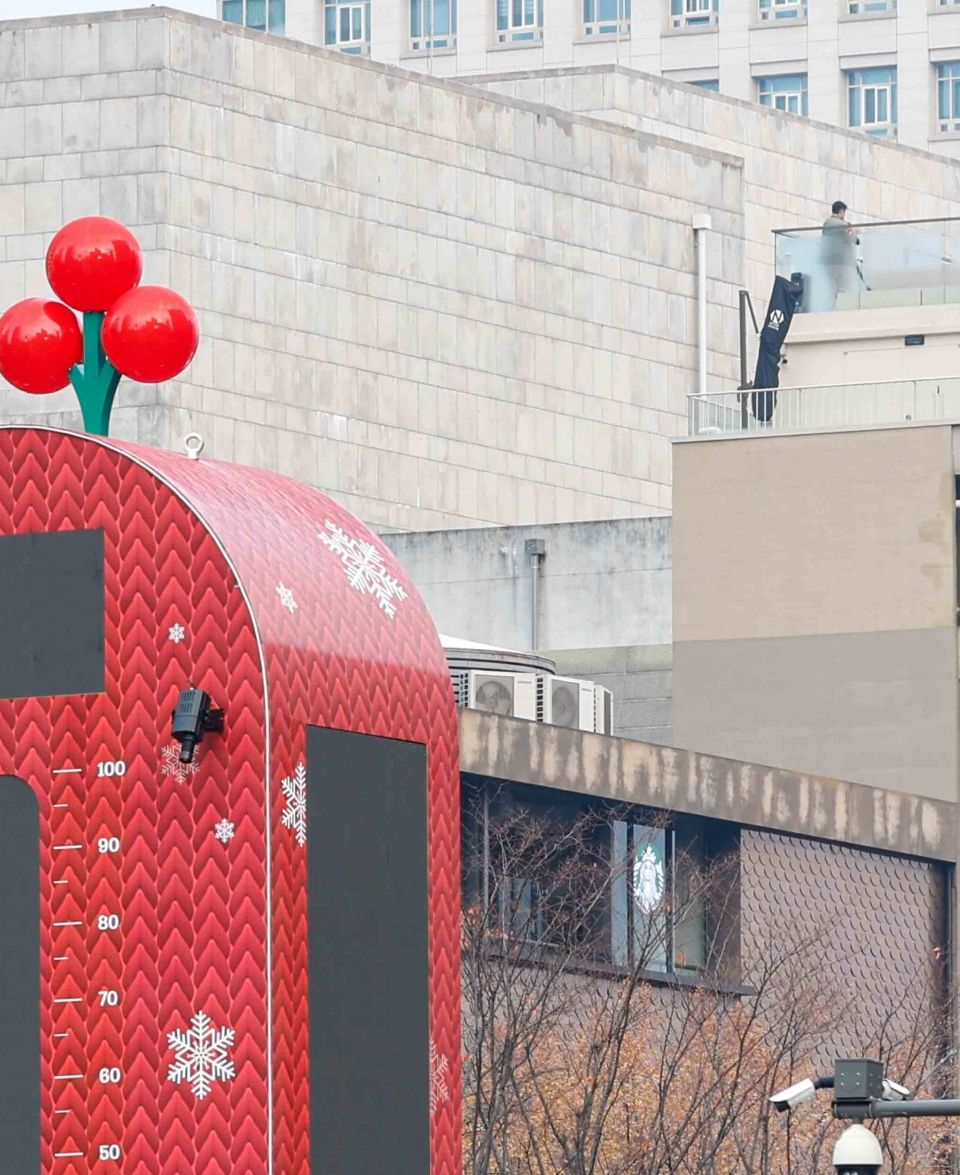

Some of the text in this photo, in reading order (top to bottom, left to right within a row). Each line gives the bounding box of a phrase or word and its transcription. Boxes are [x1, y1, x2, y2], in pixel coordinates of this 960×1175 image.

[97, 760, 126, 777] 100
[98, 837, 120, 853] 90
[97, 914, 119, 930] 80
[97, 990, 118, 1006] 70
[98, 1067, 121, 1083] 60
[99, 1144, 120, 1160] 50
